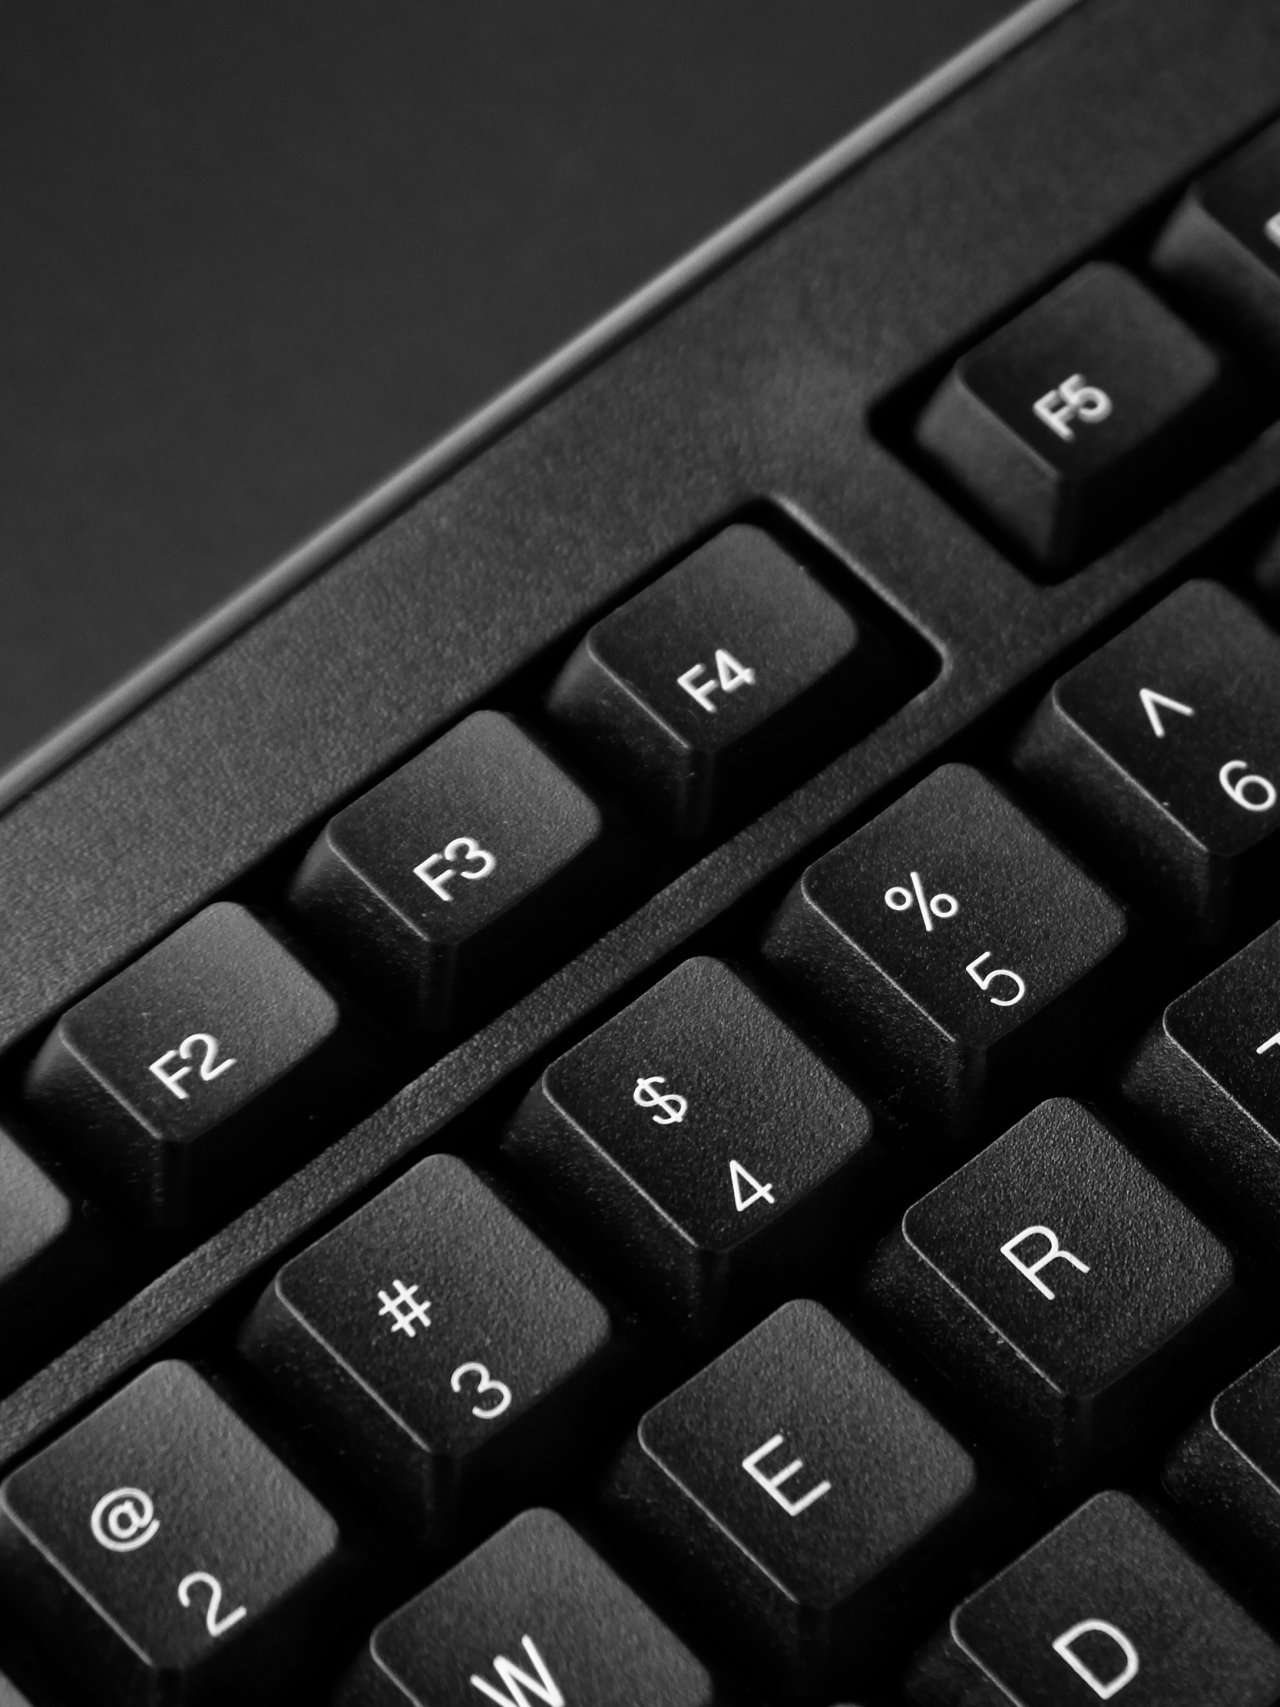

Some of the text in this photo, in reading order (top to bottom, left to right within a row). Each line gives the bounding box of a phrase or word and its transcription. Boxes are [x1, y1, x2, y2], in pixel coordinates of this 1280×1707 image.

[1032, 373, 1112, 442] F5
[676, 648, 756, 714] F4
[1138, 687, 1195, 738] ^
[1218, 759, 1278, 813] 6
[412, 836, 497, 902] F3
[883, 870, 960, 933] %
[965, 950, 1027, 1009] 5
[148, 1032, 238, 1100] F2
[632, 1075, 689, 1126] $
[728, 1159, 776, 1213] 4
[1000, 1224, 1091, 1301] R
[377, 1279, 432, 1338] #
[449, 1361, 513, 1420] 3
[740, 1433, 833, 1517] E
[90, 1486, 161, 1553] @
[177, 1570, 248, 1638] 2
[469, 1634, 566, 1707] W
[1050, 1618, 1140, 1701] D
